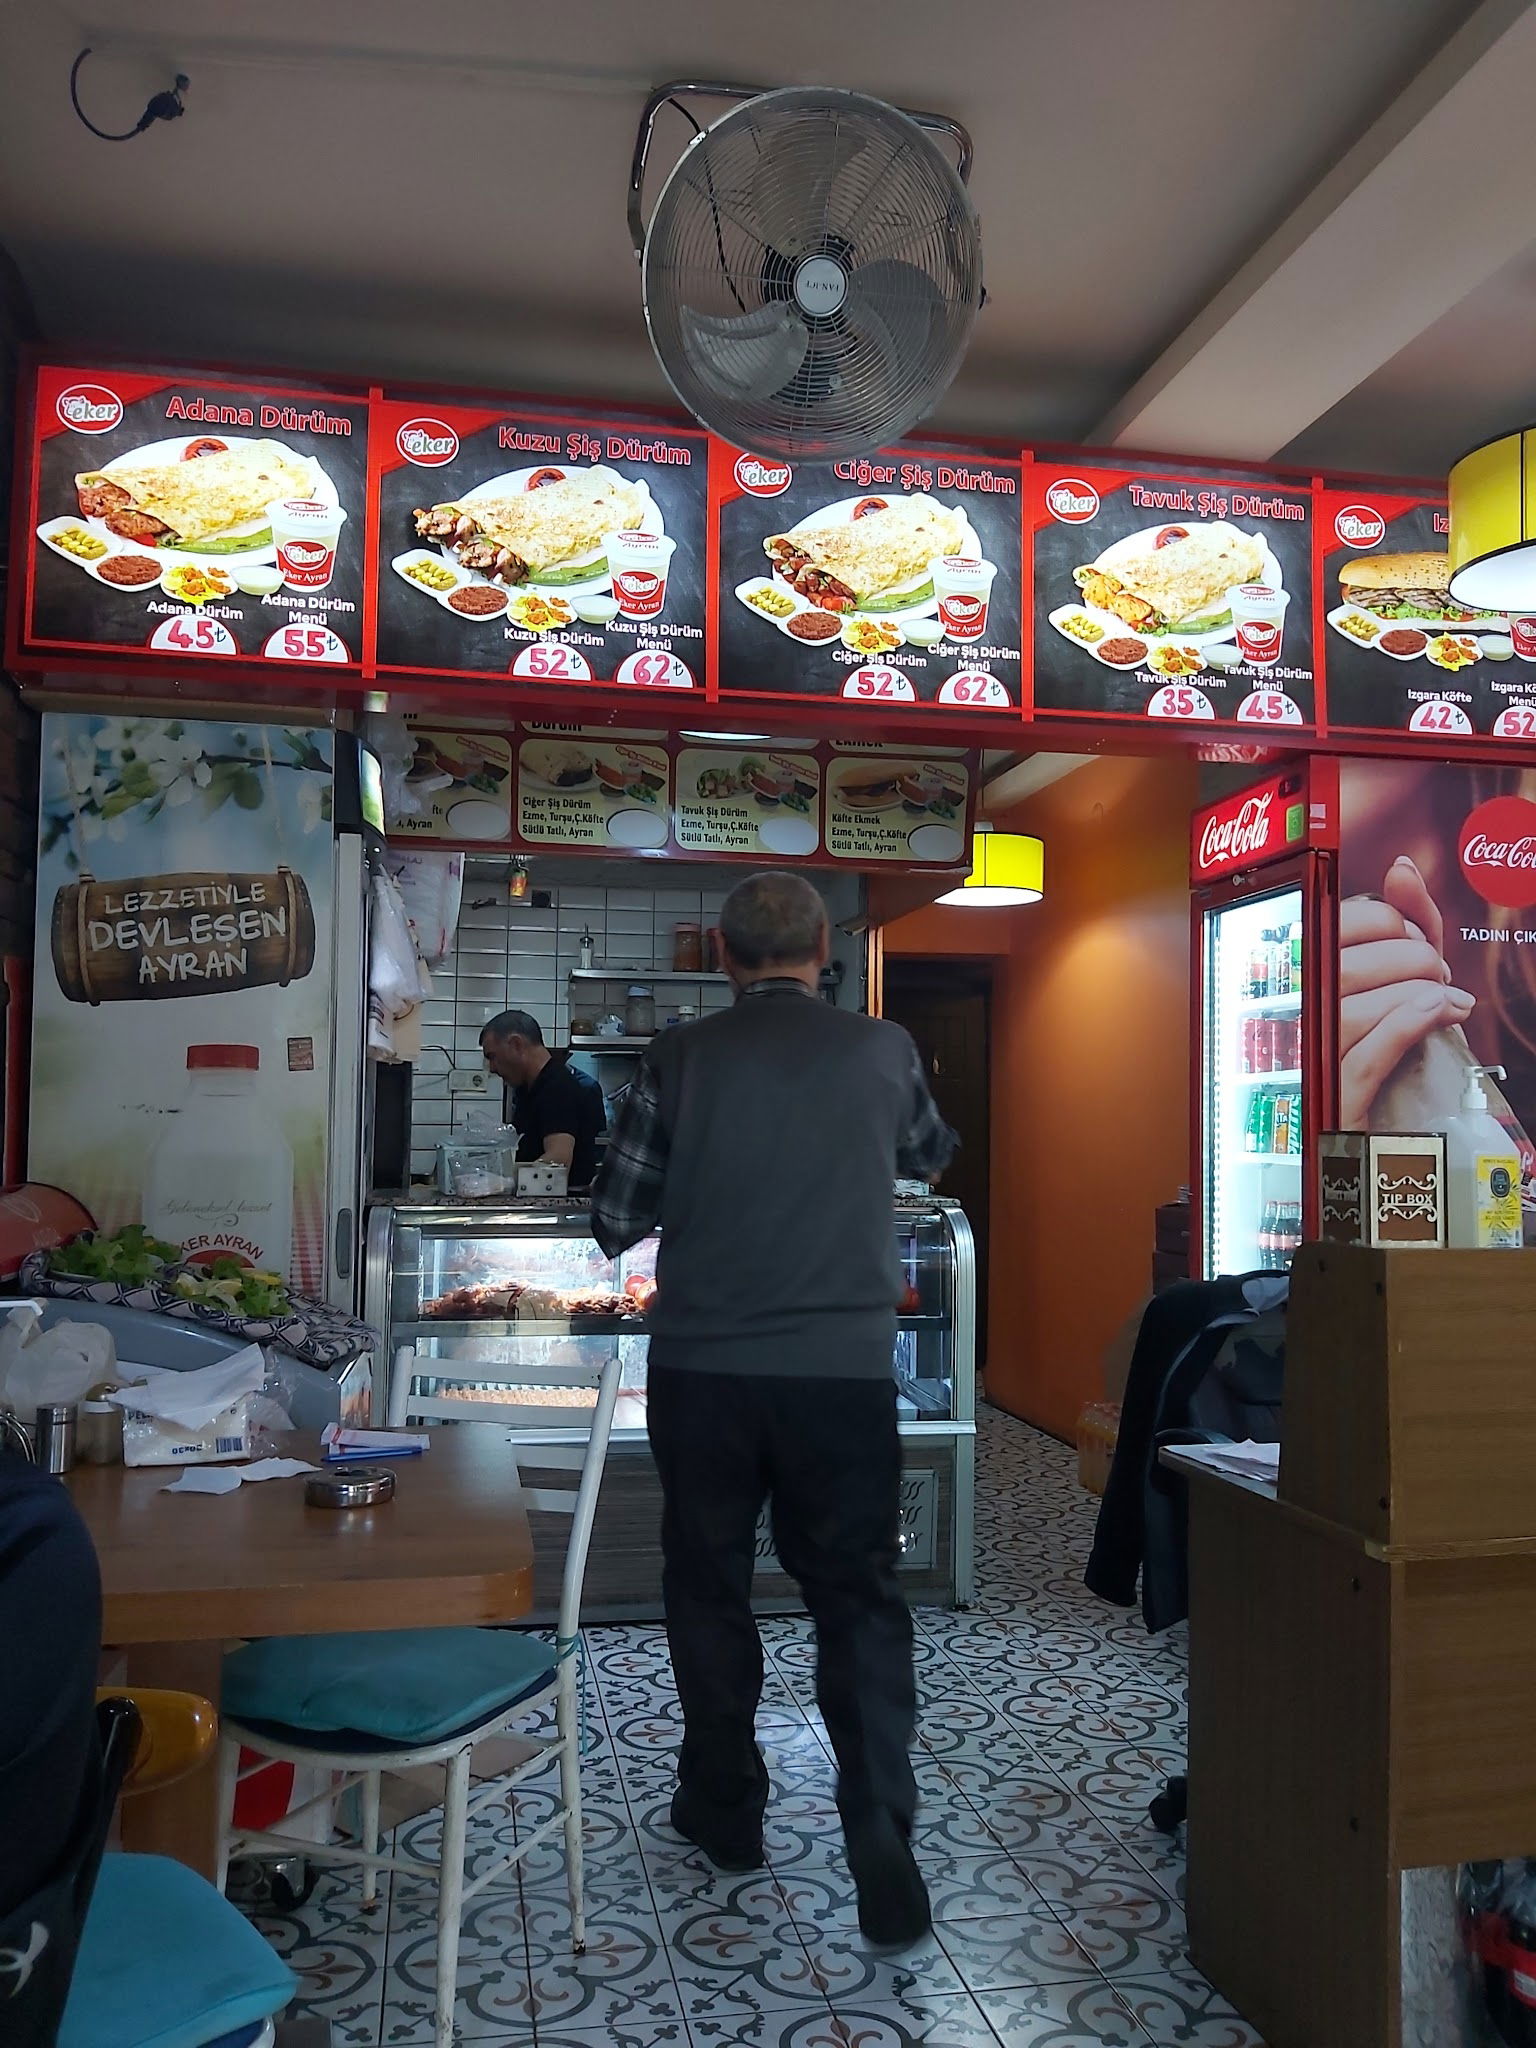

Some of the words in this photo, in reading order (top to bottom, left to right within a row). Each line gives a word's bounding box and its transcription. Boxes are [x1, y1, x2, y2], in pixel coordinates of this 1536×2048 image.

[166, 396, 253, 425] Adana
[260, 405, 352, 436] Dürüm
[498, 427, 561, 453] Kuzu
[567, 433, 601, 463] Şiş
[606, 437, 692, 466] Dürüm
[834, 459, 897, 487] Ciğer
[900, 463, 933, 492] Şiş
[937, 467, 1016, 495] Dürüm
[1129, 485, 1194, 511] Tavuk
[1198, 492, 1228, 518] Şiş
[1232, 497, 1305, 521] Dürüm
[147, 600, 193, 616] Adana
[195, 603, 244, 620] Dürüm
[261, 593, 306, 609] Adana
[309, 597, 355, 612] Dürüm
[288, 609, 327, 625] Menü
[504, 627, 538, 642] Kuzu
[538, 630, 559, 644] Şiş
[560, 630, 605, 647] Dürüm
[605, 620, 638, 635] Kuzu
[639, 622, 659, 638] Şiş
[660, 624, 703, 640] Dürüm
[636, 637, 672, 651] Menü
[927, 643, 960, 658] Ciğer
[960, 645, 980, 659] Şiş
[980, 646, 1021, 661] Dürüm
[832, 651, 866, 665] Ciğer
[866, 653, 884, 666] Şiş
[885, 653, 928, 668] Dürüm
[957, 659, 991, 673] Menü
[1135, 671, 1169, 685] Tavuk
[1170, 674, 1187, 687] Şiş
[1188, 675, 1226, 689] Dürüm
[1223, 664, 1256, 677] Tavuk
[1258, 666, 1274, 679] Şiş
[1275, 667, 1313, 681] Dürüm
[1252, 679, 1284, 692] Menü
[1491, 681, 1524, 695] Izgara
[1407, 689, 1441, 703] Izgara
[1441, 690, 1473, 704] Köfte
[522, 796, 546, 809] Ciğer
[547, 798, 560, 810] Şiş
[562, 798, 591, 809] Dürüm
[522, 811, 547, 822] Ezme,
[681, 805, 704, 816] Tavuk
[706, 806, 718, 818] Şiş
[720, 807, 748, 818] Dürüm
[832, 813, 852, 824] Köfte
[854, 814, 881, 825] Ekmek
[407, 819, 432, 830] Ayran
[522, 824, 545, 835] Sütlü
[568, 827, 594, 839] Ayran
[681, 818, 705, 830] Ezme,
[1199, 790, 1274, 869] Coca-Cola
[681, 832, 702, 843] Sütlü
[725, 834, 749, 846] Ayran
[832, 827, 854, 838] Ezme,
[832, 840, 851, 850] Sütlü
[874, 842, 897, 854] Ayran
[105, 881, 267, 915] LEZZETİYLE
[87, 907, 288, 952] DEVLEŞEN
[1460, 928, 1510, 942] TADINI
[138, 948, 249, 985] AYRAN
[1382, 1194, 1403, 1205] TIP
[1407, 1193, 1434, 1205] BOX
[213, 1233, 264, 1260] AYRAN
